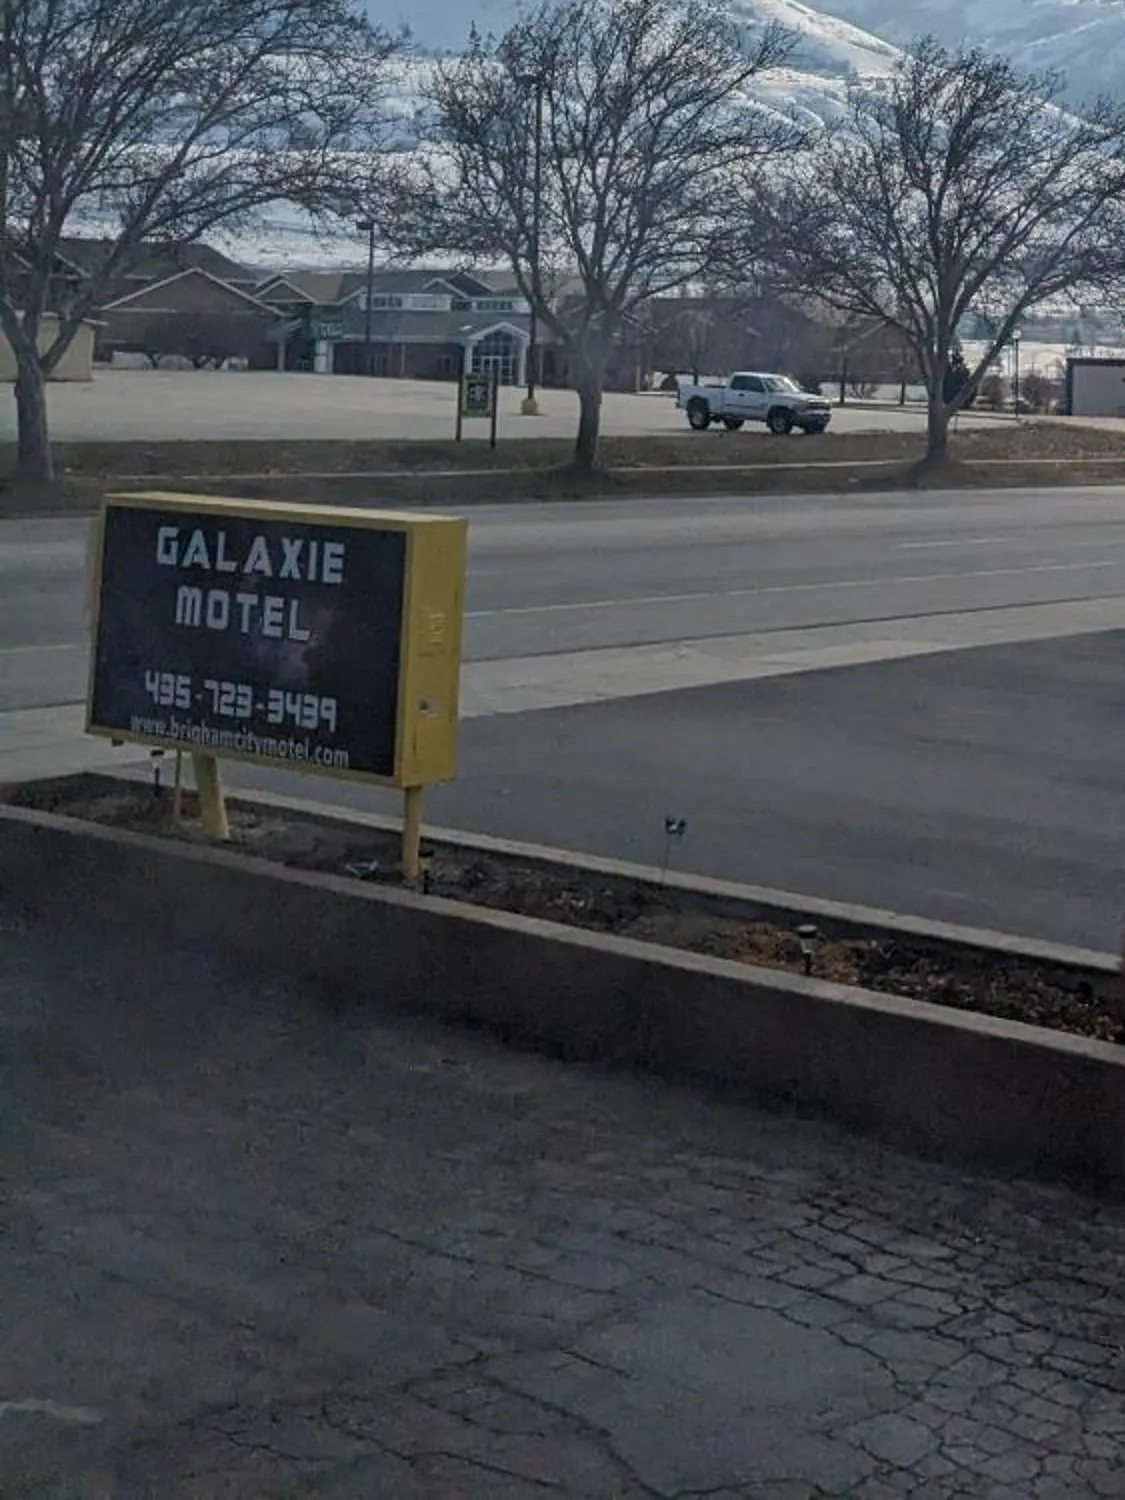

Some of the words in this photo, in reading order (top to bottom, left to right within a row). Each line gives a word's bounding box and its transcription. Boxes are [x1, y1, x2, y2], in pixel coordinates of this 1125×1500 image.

[157, 526, 345, 584] GALAXIE
[175, 585, 311, 641] MOTEL
[144, 669, 337, 733] 435-723-3439
[131, 714, 349, 768] www.brighamcitymotel.com
